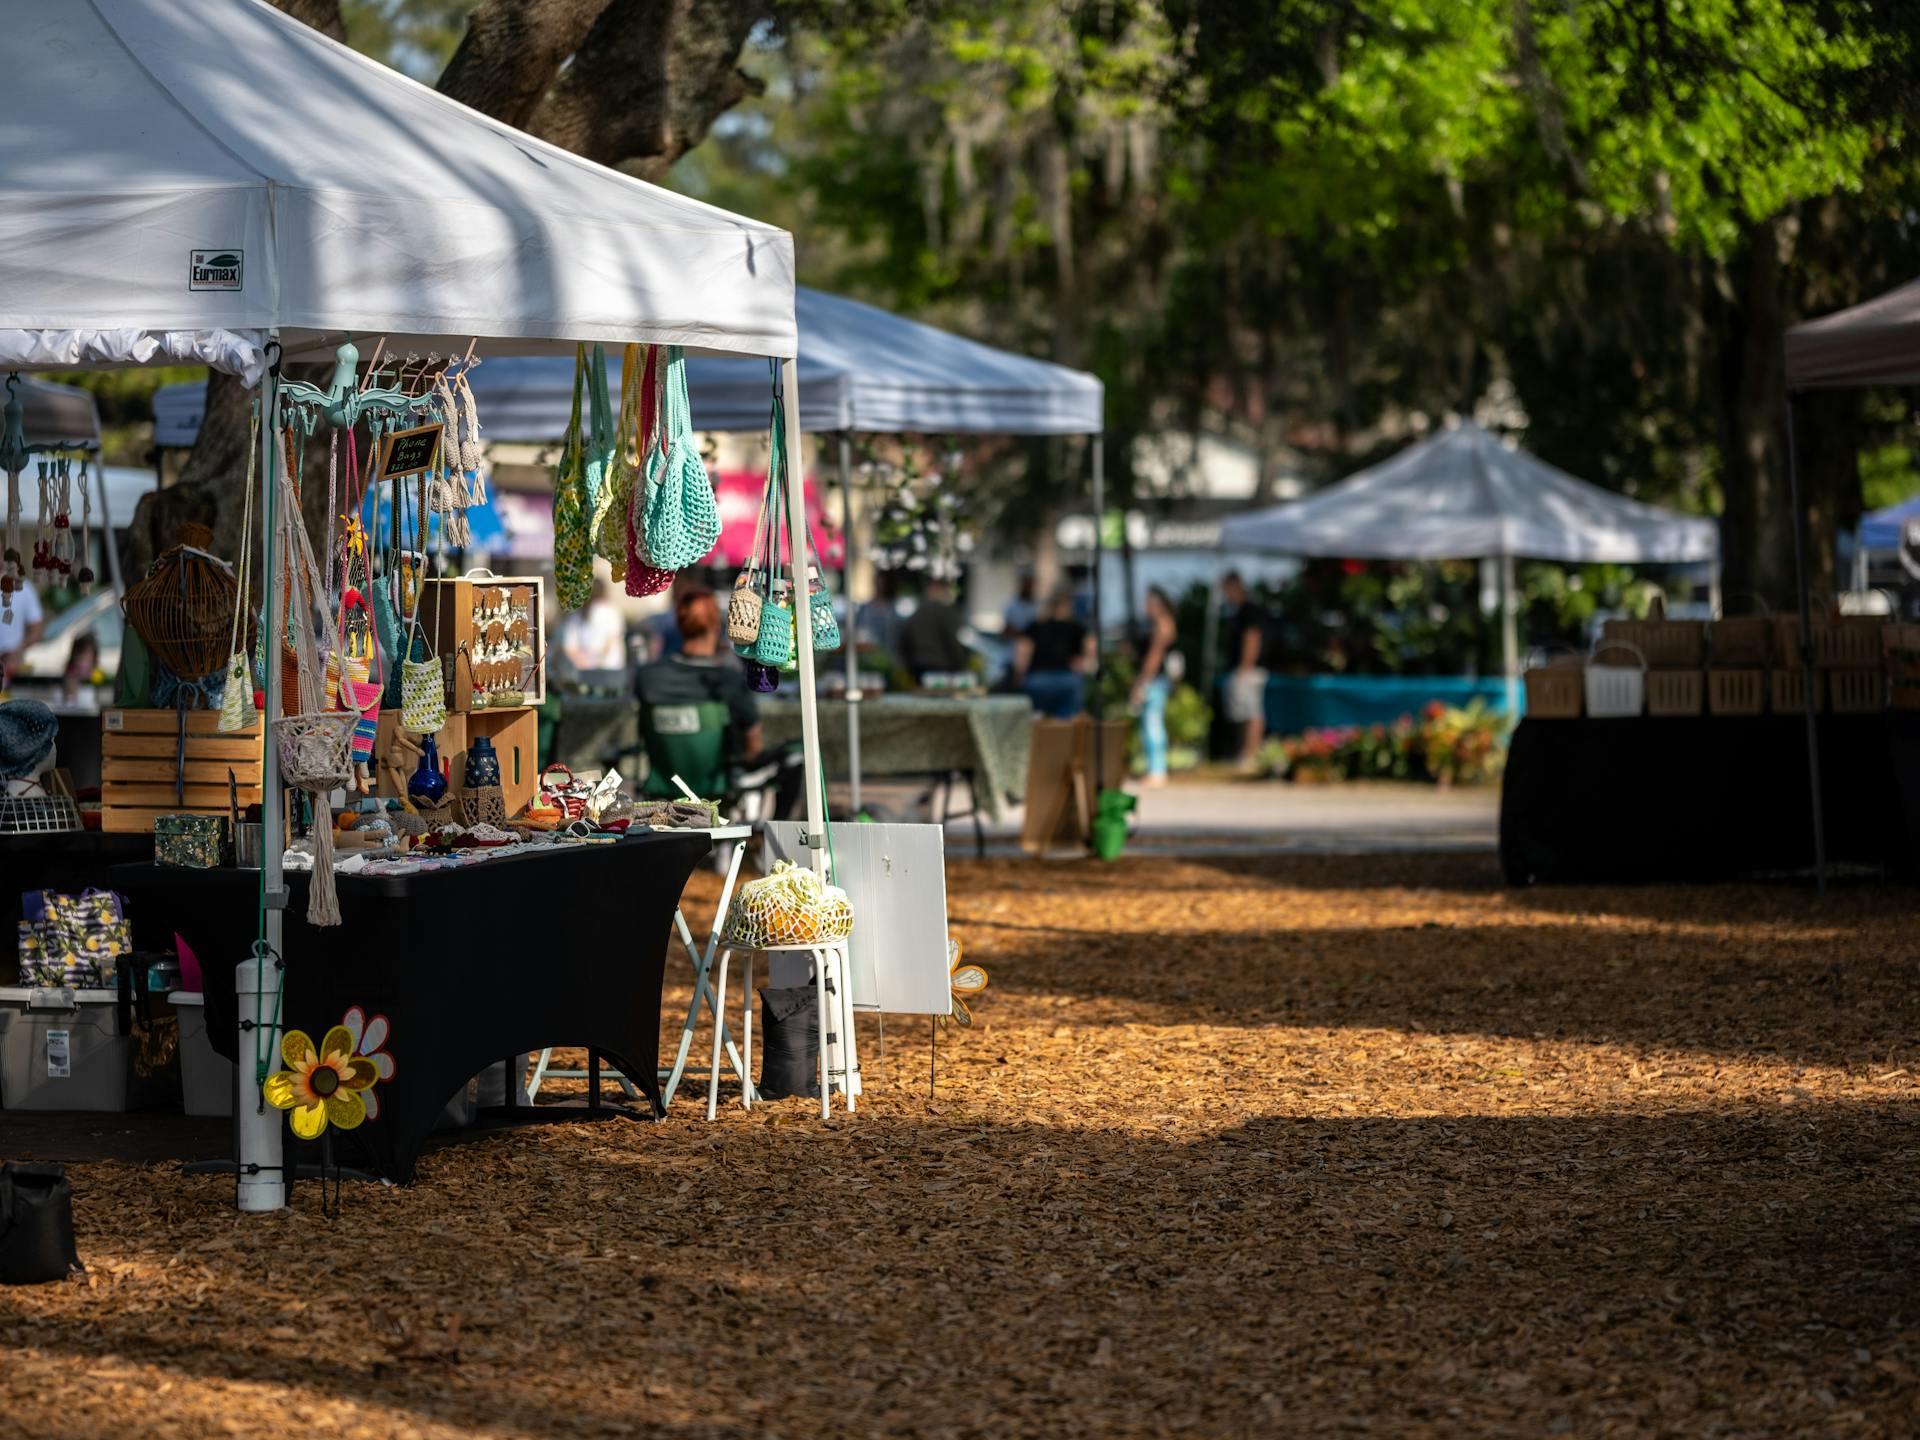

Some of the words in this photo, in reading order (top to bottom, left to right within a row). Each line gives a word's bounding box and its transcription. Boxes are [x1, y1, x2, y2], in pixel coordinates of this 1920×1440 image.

[193, 266, 237, 281] Eurmax
[398, 438, 427, 450] Phone
[397, 451, 421, 461] Bags
